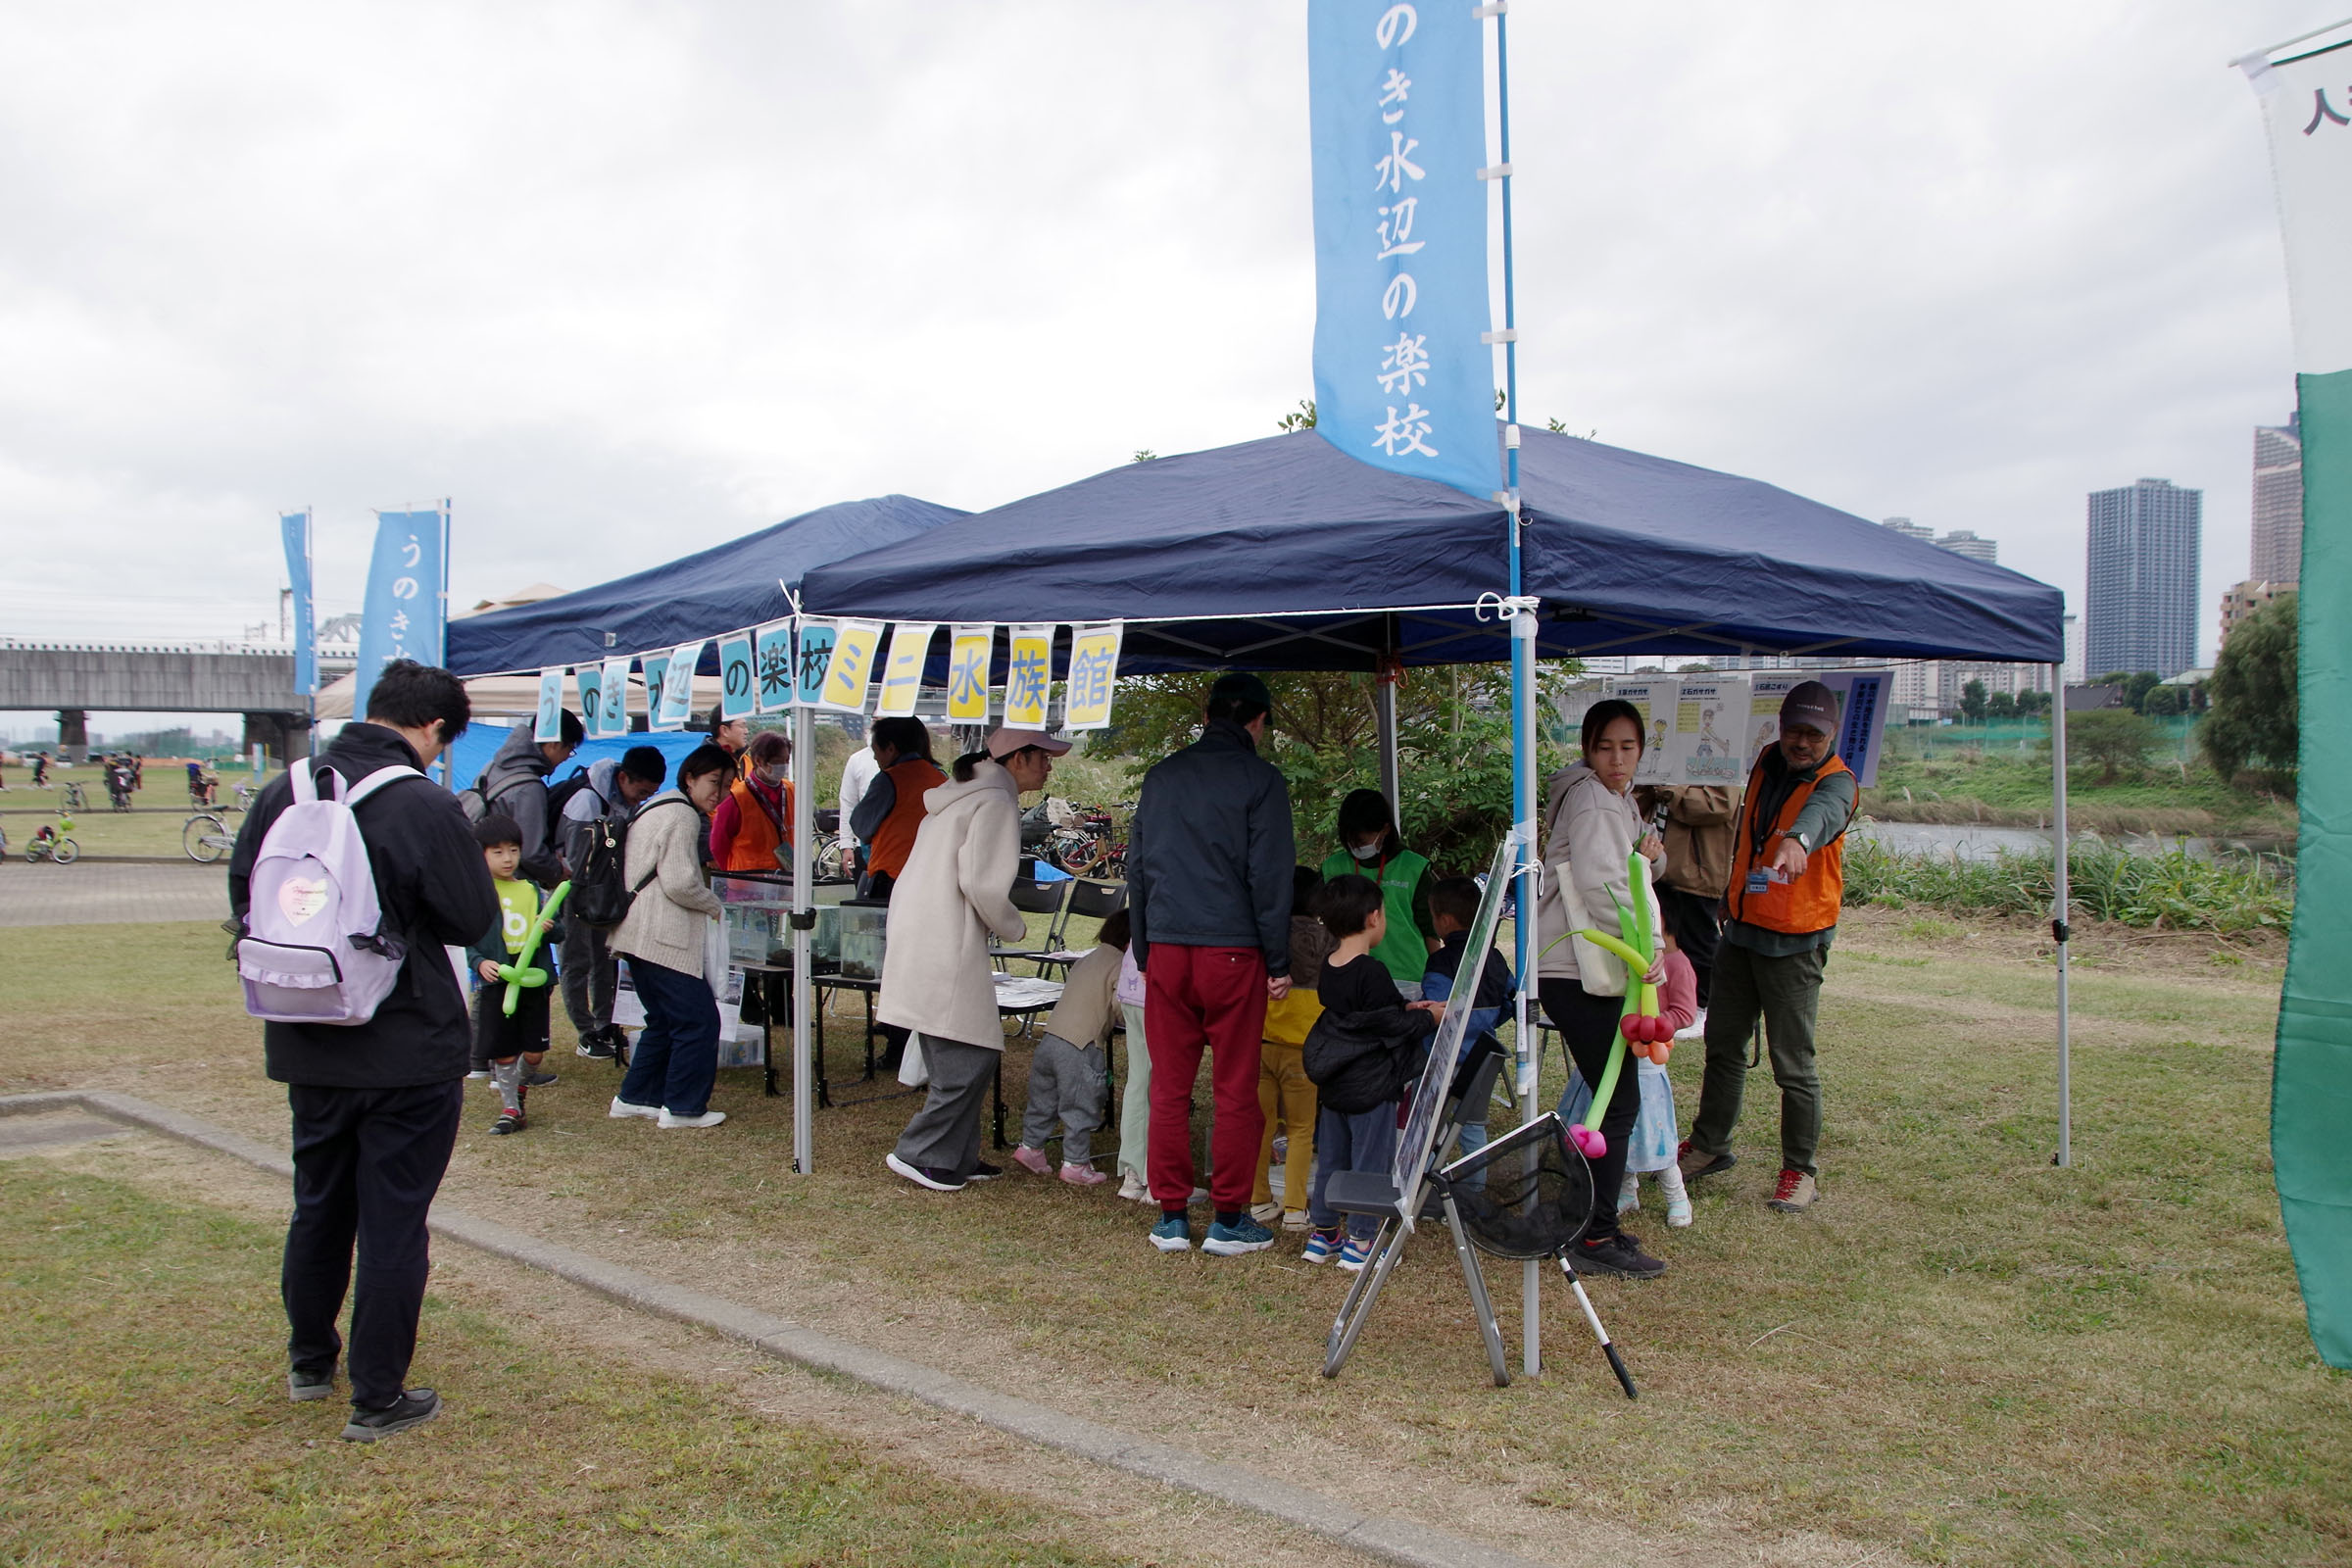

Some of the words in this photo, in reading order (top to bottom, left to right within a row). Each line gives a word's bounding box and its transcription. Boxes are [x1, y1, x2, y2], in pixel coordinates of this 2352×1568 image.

[1372, 3, 1439, 458] のき水辺の楽校
[2303, 87, 2352, 136] 人
